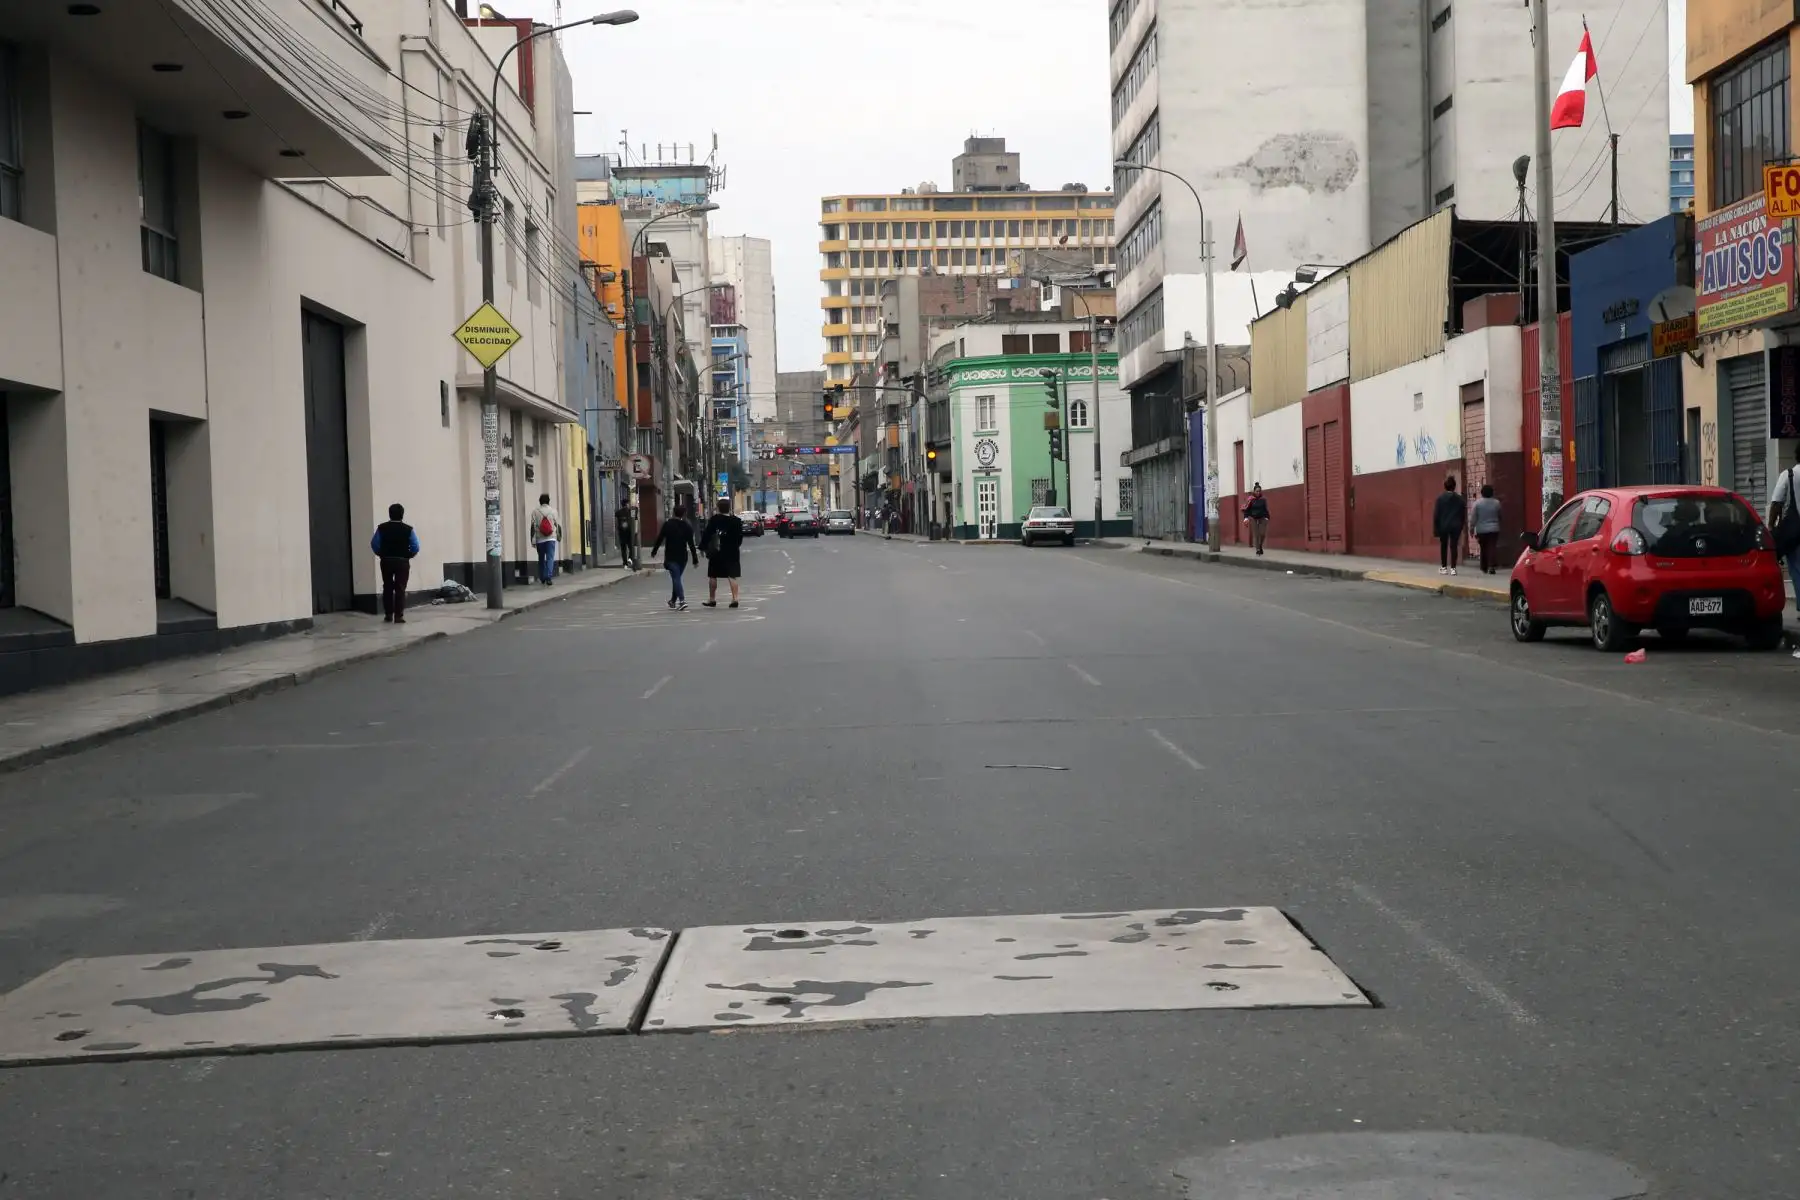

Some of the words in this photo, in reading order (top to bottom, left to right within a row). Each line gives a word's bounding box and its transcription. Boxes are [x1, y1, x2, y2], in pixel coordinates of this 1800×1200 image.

[1770, 169, 1800, 198] FO
[1771, 200, 1788, 213] AL
[1715, 230, 1728, 246] LA
[1730, 212, 1767, 240] NACIÓN
[1702, 227, 1782, 295] AVISOS
[464, 337, 512, 345] VELOCIDAD
[1690, 601, 1721, 611] AAD-677
